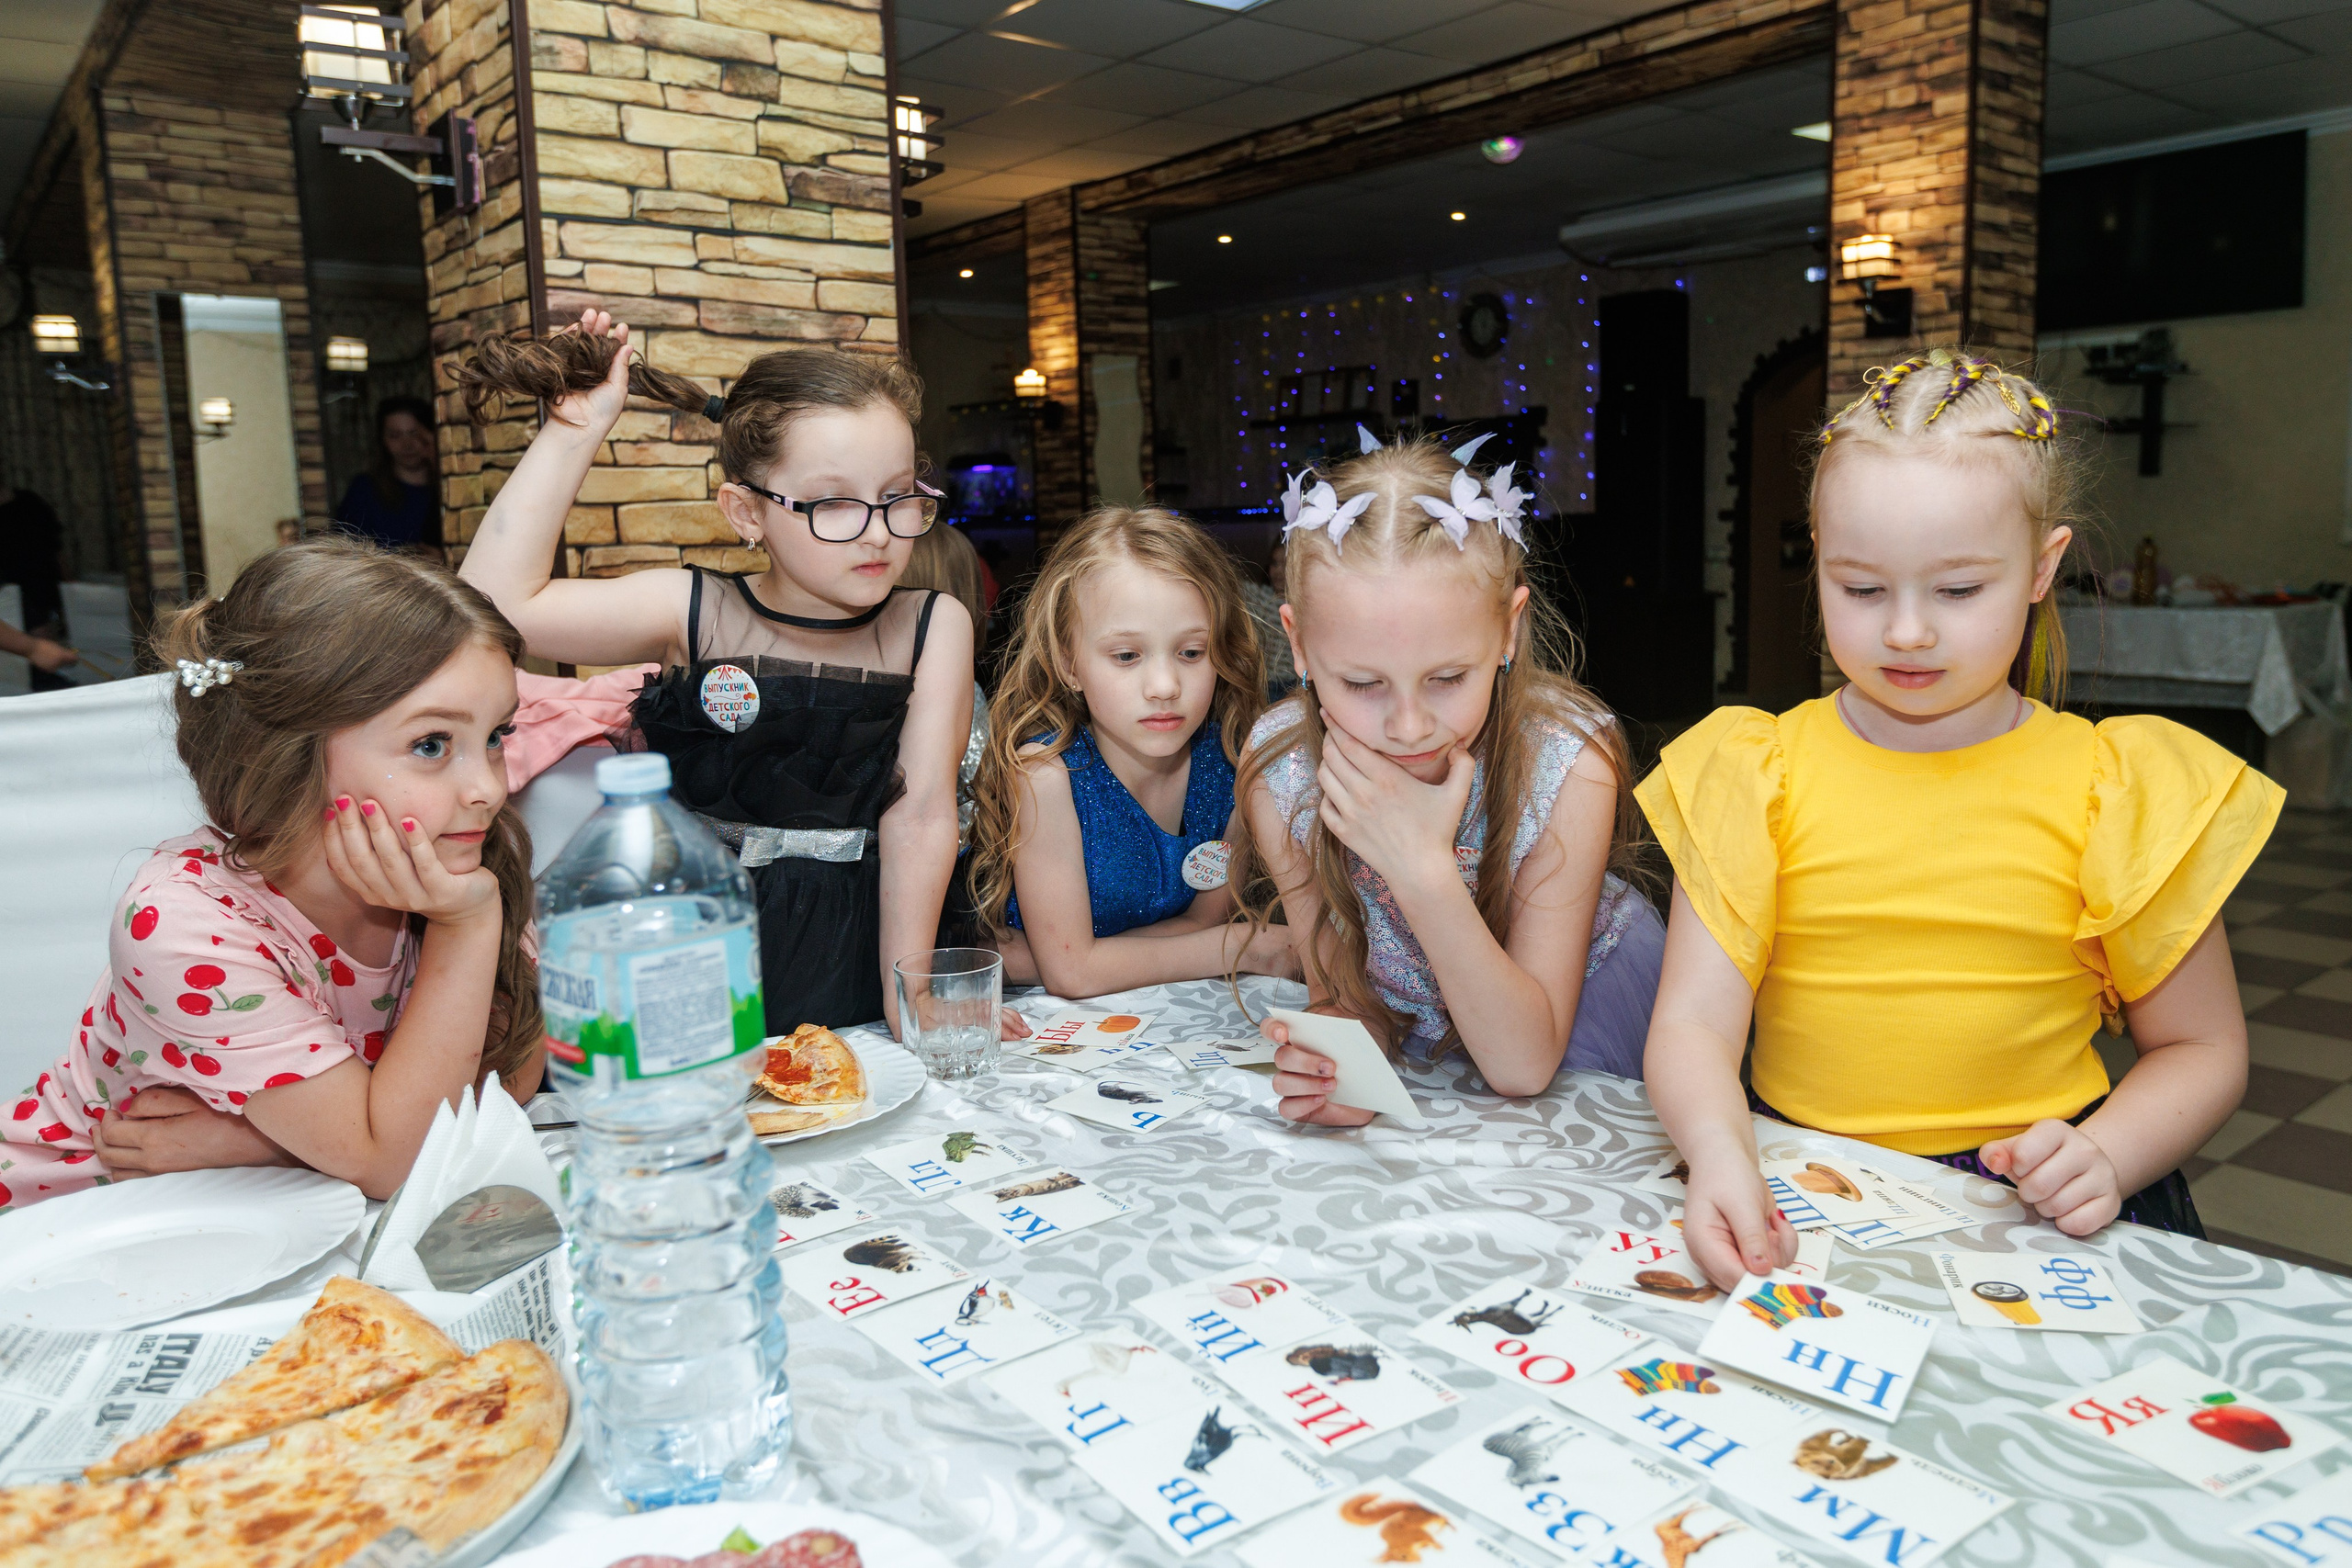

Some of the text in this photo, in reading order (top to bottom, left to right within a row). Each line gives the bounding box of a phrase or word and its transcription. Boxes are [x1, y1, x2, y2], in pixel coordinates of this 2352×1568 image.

[704, 682, 750, 693] ВЫПУСКНИК
[708, 702, 750, 712] ДЕТСКОГО
[1194, 873, 1214, 884] САДА
[1035, 1021, 1086, 1043] Ыы
[1190, 1051, 1230, 1067] Цц
[908, 1159, 962, 1192] Лл
[1096, 1190, 1131, 1212] Кошка
[1872, 1189, 1910, 1215] Шляпа
[1897, 1185, 1957, 1216] Пингвин
[999, 1205, 1061, 1244] Кк
[1610, 1231, 1680, 1264] Уу
[538, 1258, 548, 1280] The
[940, 1260, 968, 1278] Енот
[1939, 1253, 1964, 1289] Фонарик
[2038, 1258, 2114, 1310] Фф
[542, 1278, 553, 1323] discovery
[828, 1277, 888, 1315] Ее
[1573, 1280, 1632, 1298] Улитка
[1588, 1314, 1640, 1340] Ослик
[1867, 1299, 1931, 1330] Носки
[136, 1334, 164, 1355] has
[915, 1325, 998, 1379] Дд
[1185, 1309, 1266, 1363] Йй
[135, 1333, 204, 1394] ITALY
[1494, 1338, 1577, 1384] Оо
[1782, 1338, 1905, 1414] Нн
[1283, 1382, 1375, 1448] Ии
[1751, 1383, 1813, 1416] Носки
[2067, 1395, 2171, 1436] Яя
[1066, 1402, 1135, 1446] Гг
[1631, 1404, 1748, 1472] Нн
[1157, 1475, 1243, 1546] Вв
[1525, 1491, 1617, 1552] Зз
[1791, 1482, 1939, 1568] Мм
